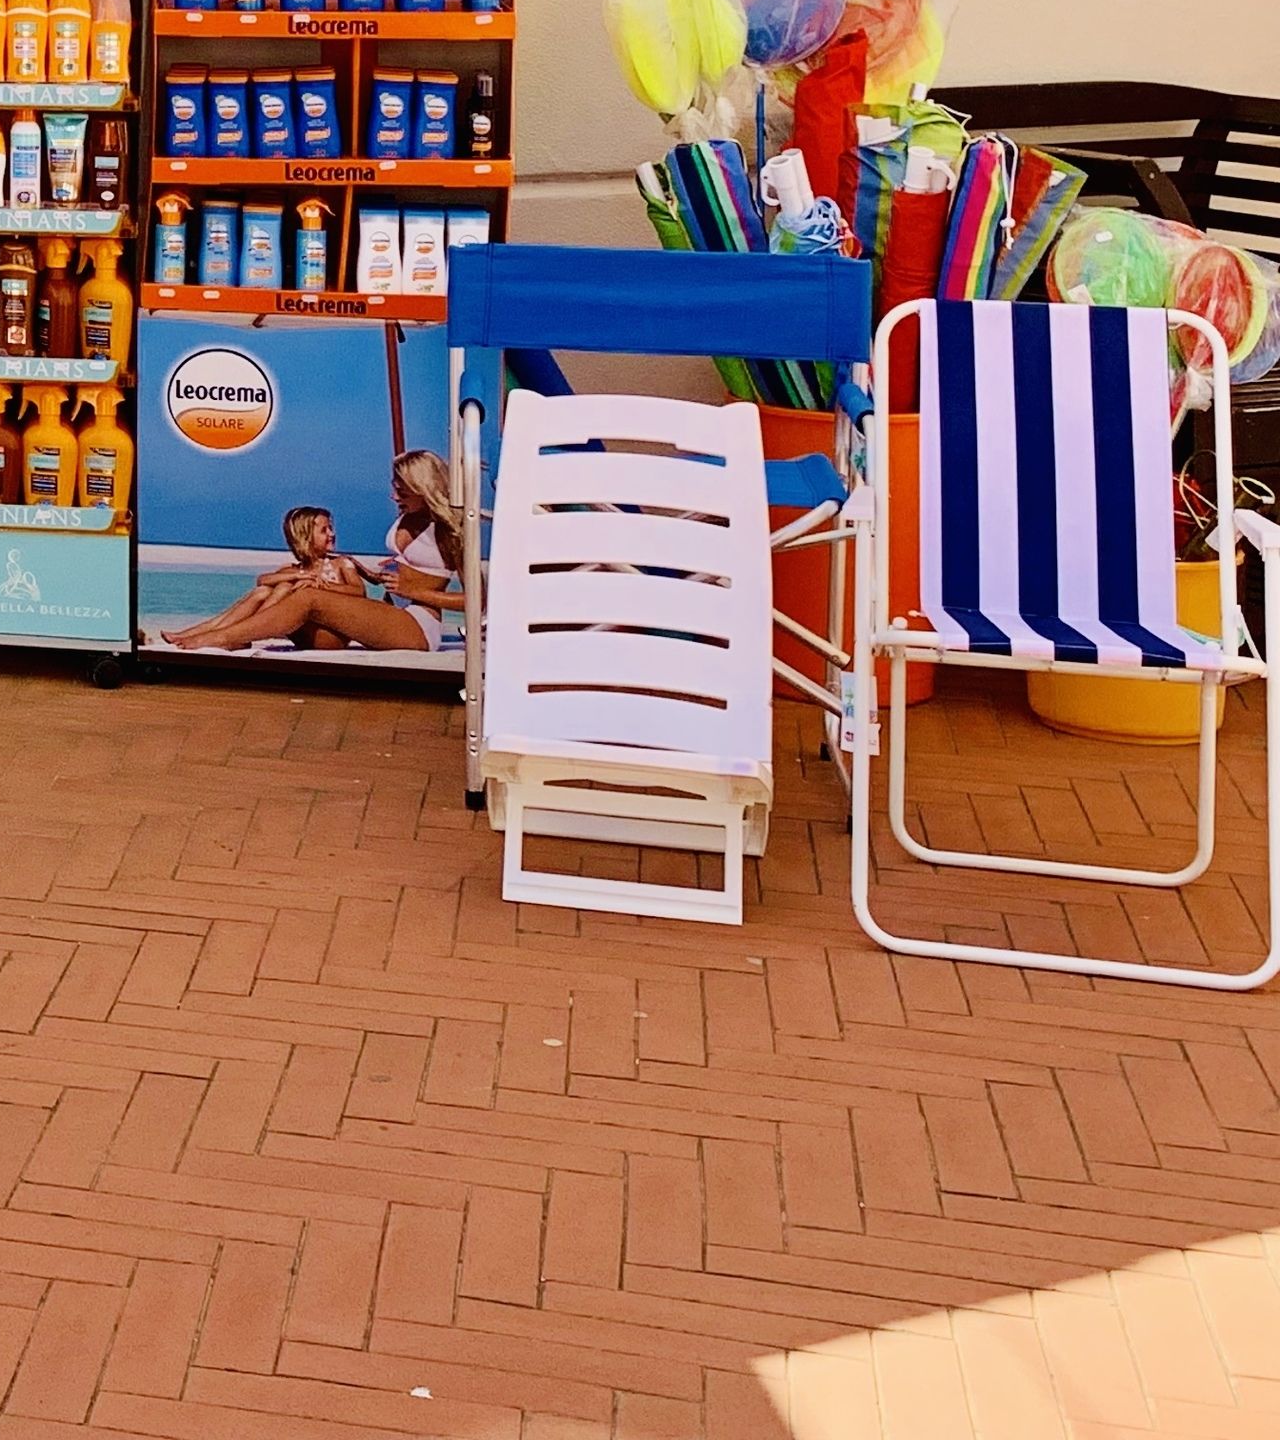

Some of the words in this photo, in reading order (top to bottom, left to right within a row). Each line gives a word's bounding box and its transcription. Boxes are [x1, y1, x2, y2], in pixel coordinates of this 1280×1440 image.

[285, 163, 375, 182] Leocrema
[175, 379, 267, 404] Leocrema
[196, 417, 245, 430] SOLARE
[40, 605, 111, 618] BELLEZZA
